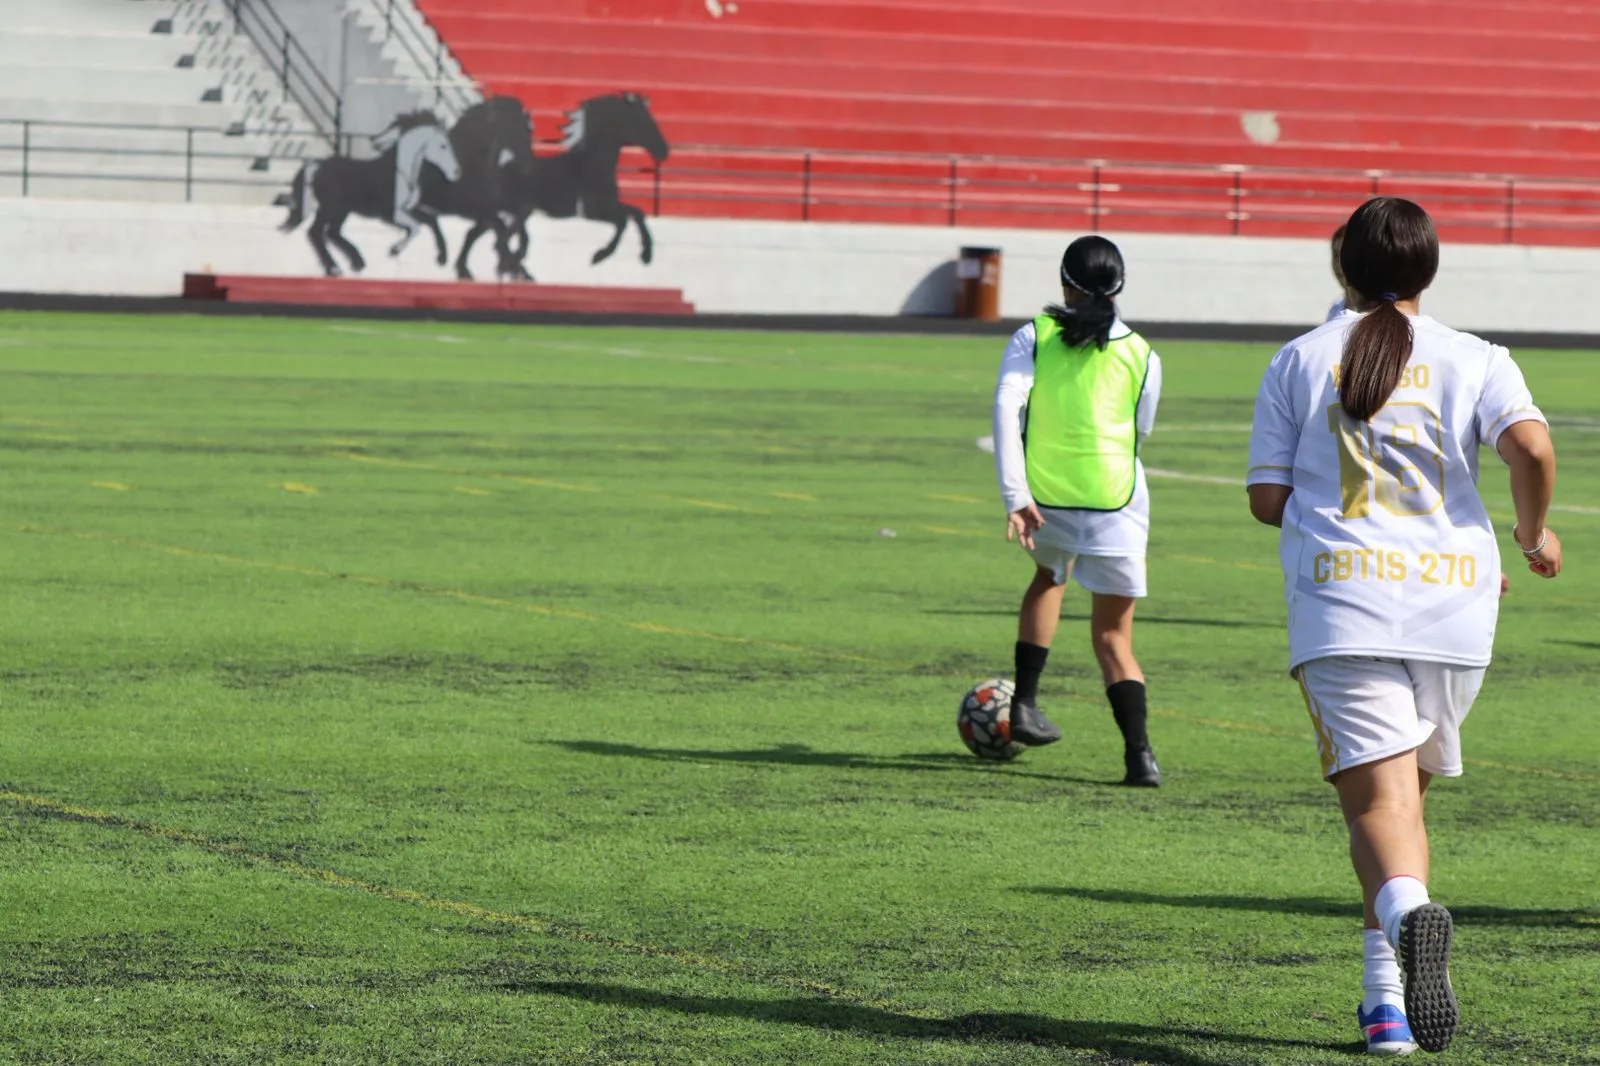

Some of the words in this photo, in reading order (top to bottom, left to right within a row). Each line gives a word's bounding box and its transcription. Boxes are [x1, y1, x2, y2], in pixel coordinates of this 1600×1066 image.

[1327, 402, 1444, 519] 18
[1313, 548, 1407, 584] CBTIS
[1419, 552, 1476, 587] 270
